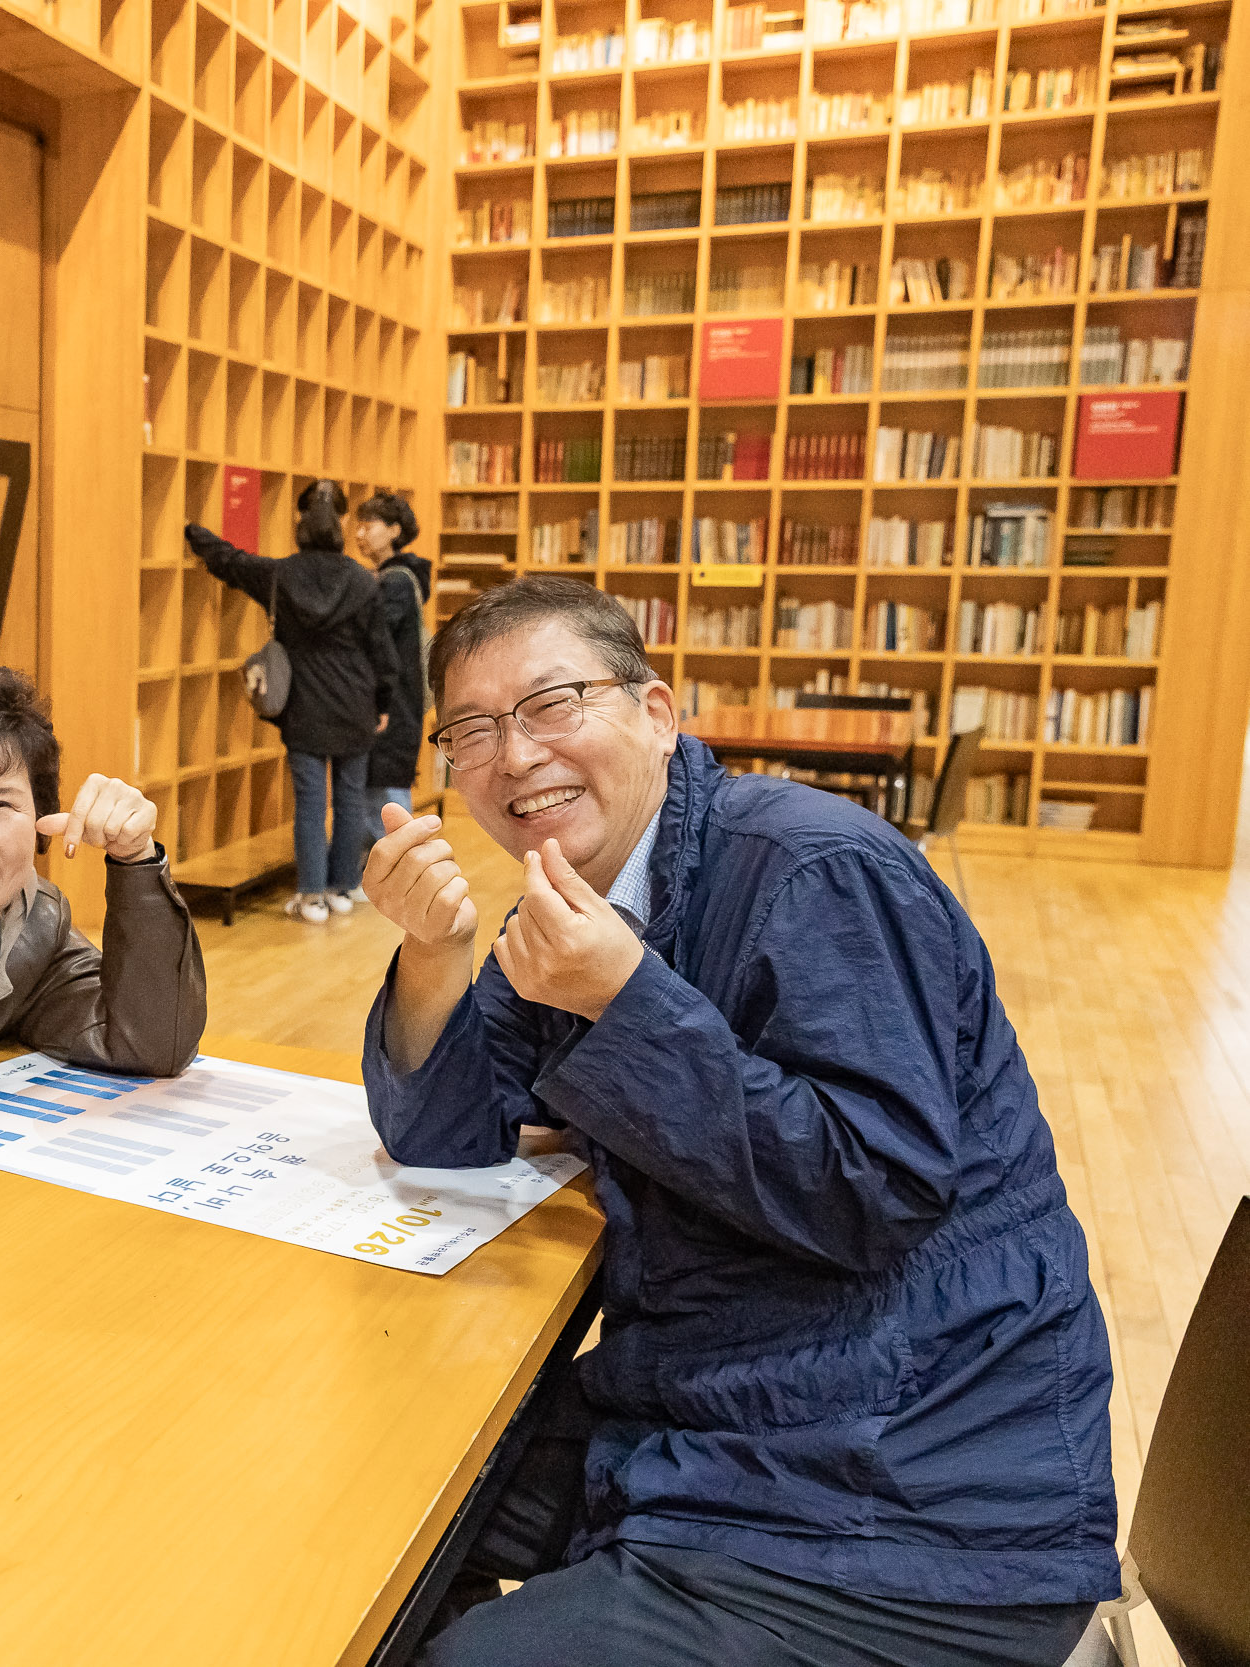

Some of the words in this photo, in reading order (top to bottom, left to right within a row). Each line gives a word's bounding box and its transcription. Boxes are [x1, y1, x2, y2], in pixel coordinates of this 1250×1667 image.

[200, 1132, 291, 1176] 음악으로
[269, 1154, 307, 1166] 책
[241, 1169, 277, 1179] 속
[148, 1177, 206, 1203] 날다
[182, 1185, 253, 1211] 나비,
[417, 1195, 438, 1207] SUN
[351, 1193, 390, 1215] 16:30
[353, 1207, 443, 1256] 10/26
